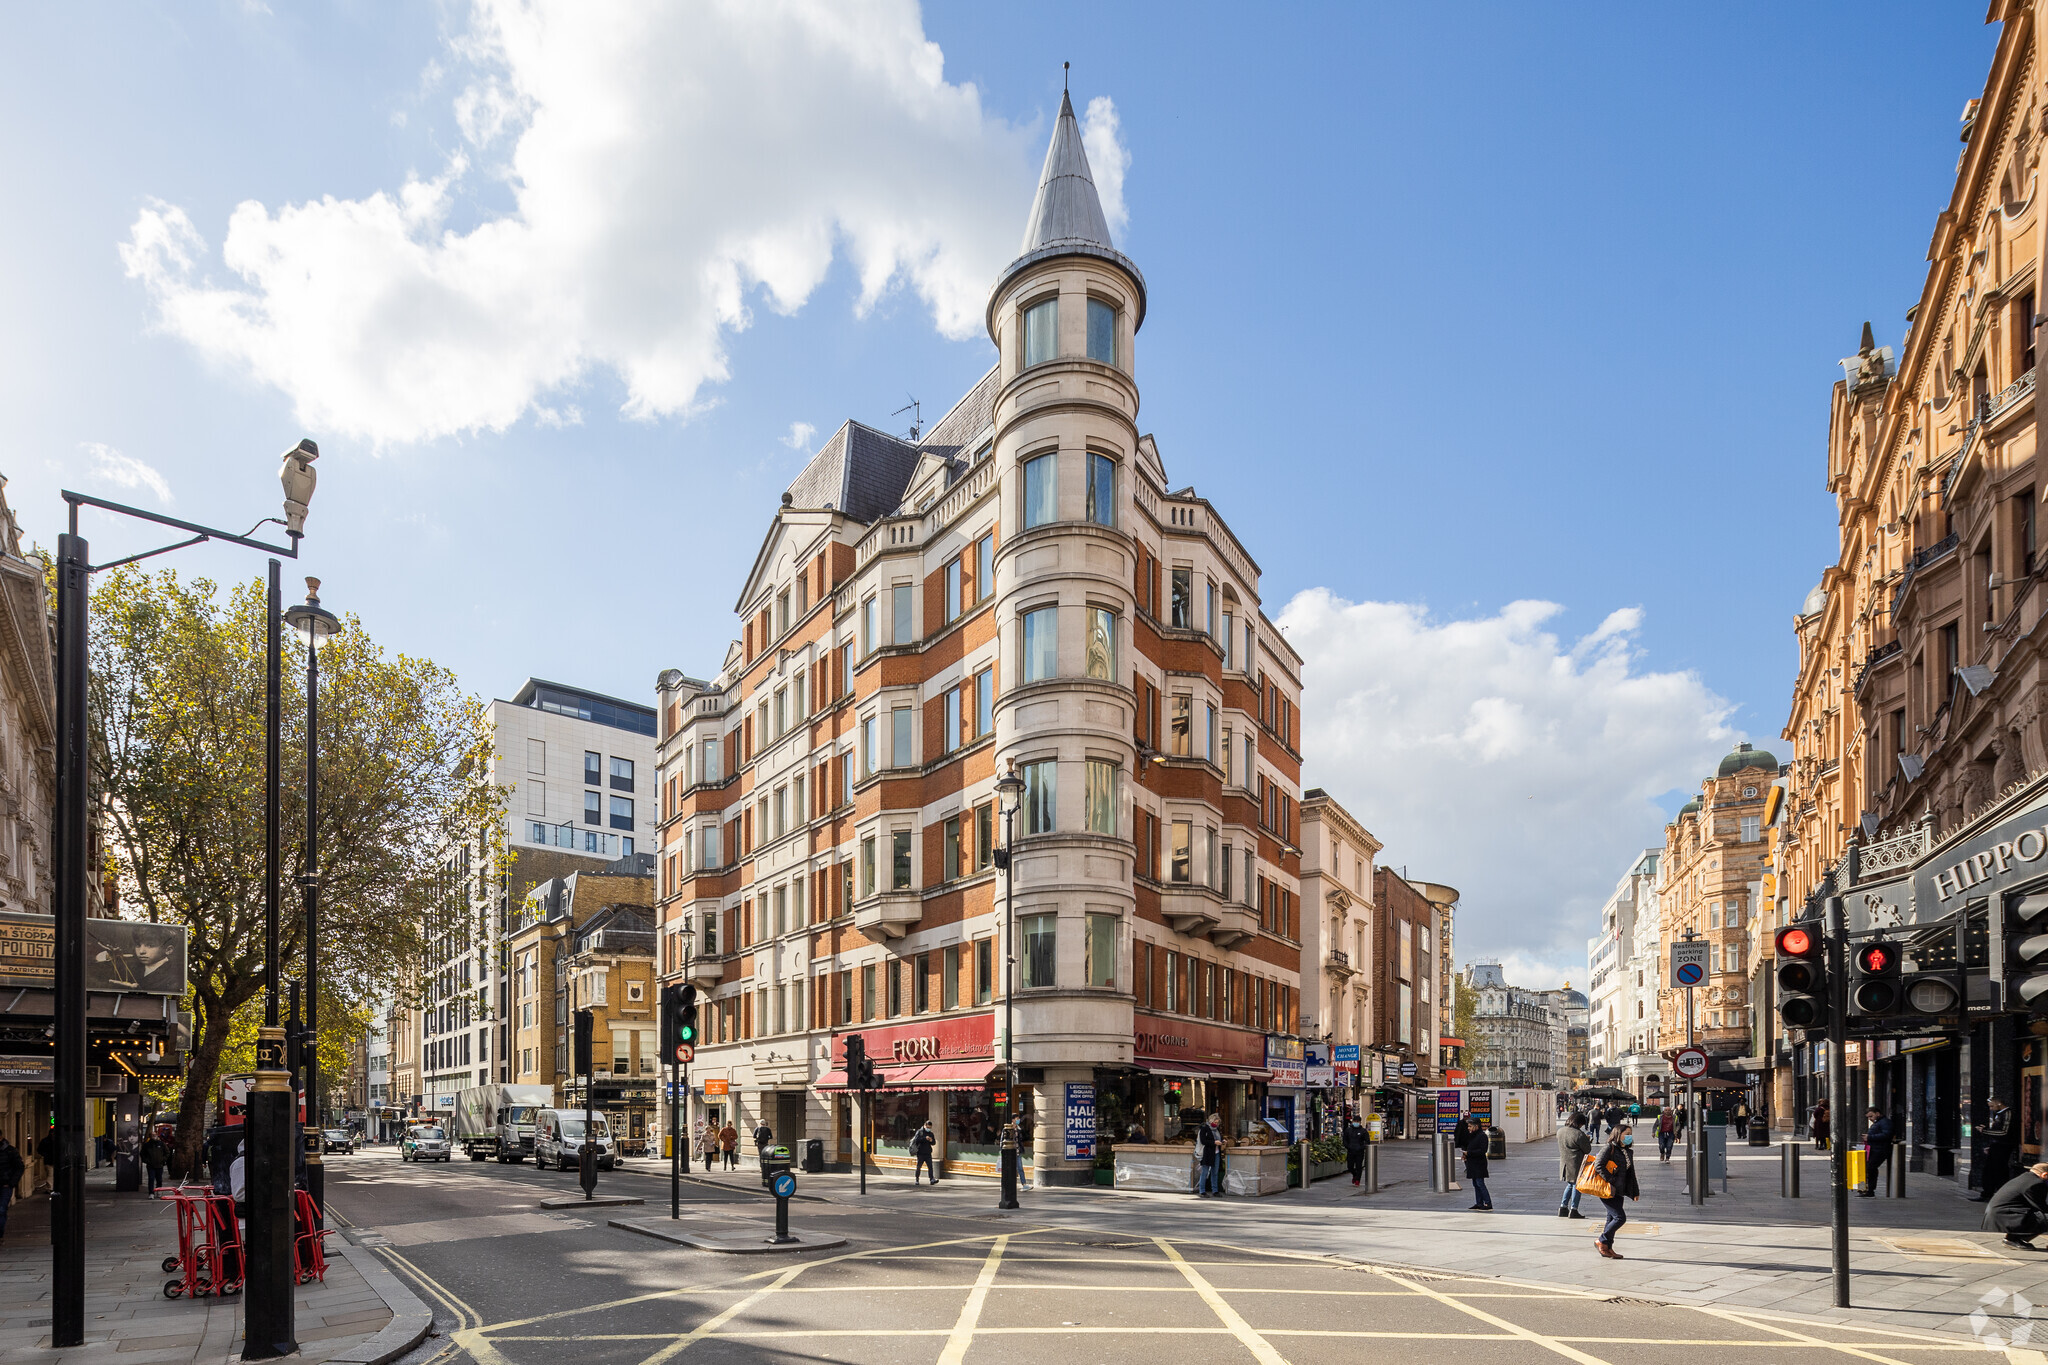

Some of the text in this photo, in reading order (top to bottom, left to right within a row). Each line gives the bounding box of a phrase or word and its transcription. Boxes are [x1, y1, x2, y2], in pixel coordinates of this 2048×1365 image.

[8, 966, 40, 974] PATRICK
[1160, 1034, 1190, 1047] CORNER
[892, 1035, 937, 1059] FIORI
[964, 1042, 983, 1054] bistro
[1286, 1070, 1300, 1080] PRICE
[620, 1090, 638, 1099] THE
[1067, 1105, 1096, 1117] HALF
[1066, 1117, 1096, 1129] PRICE
